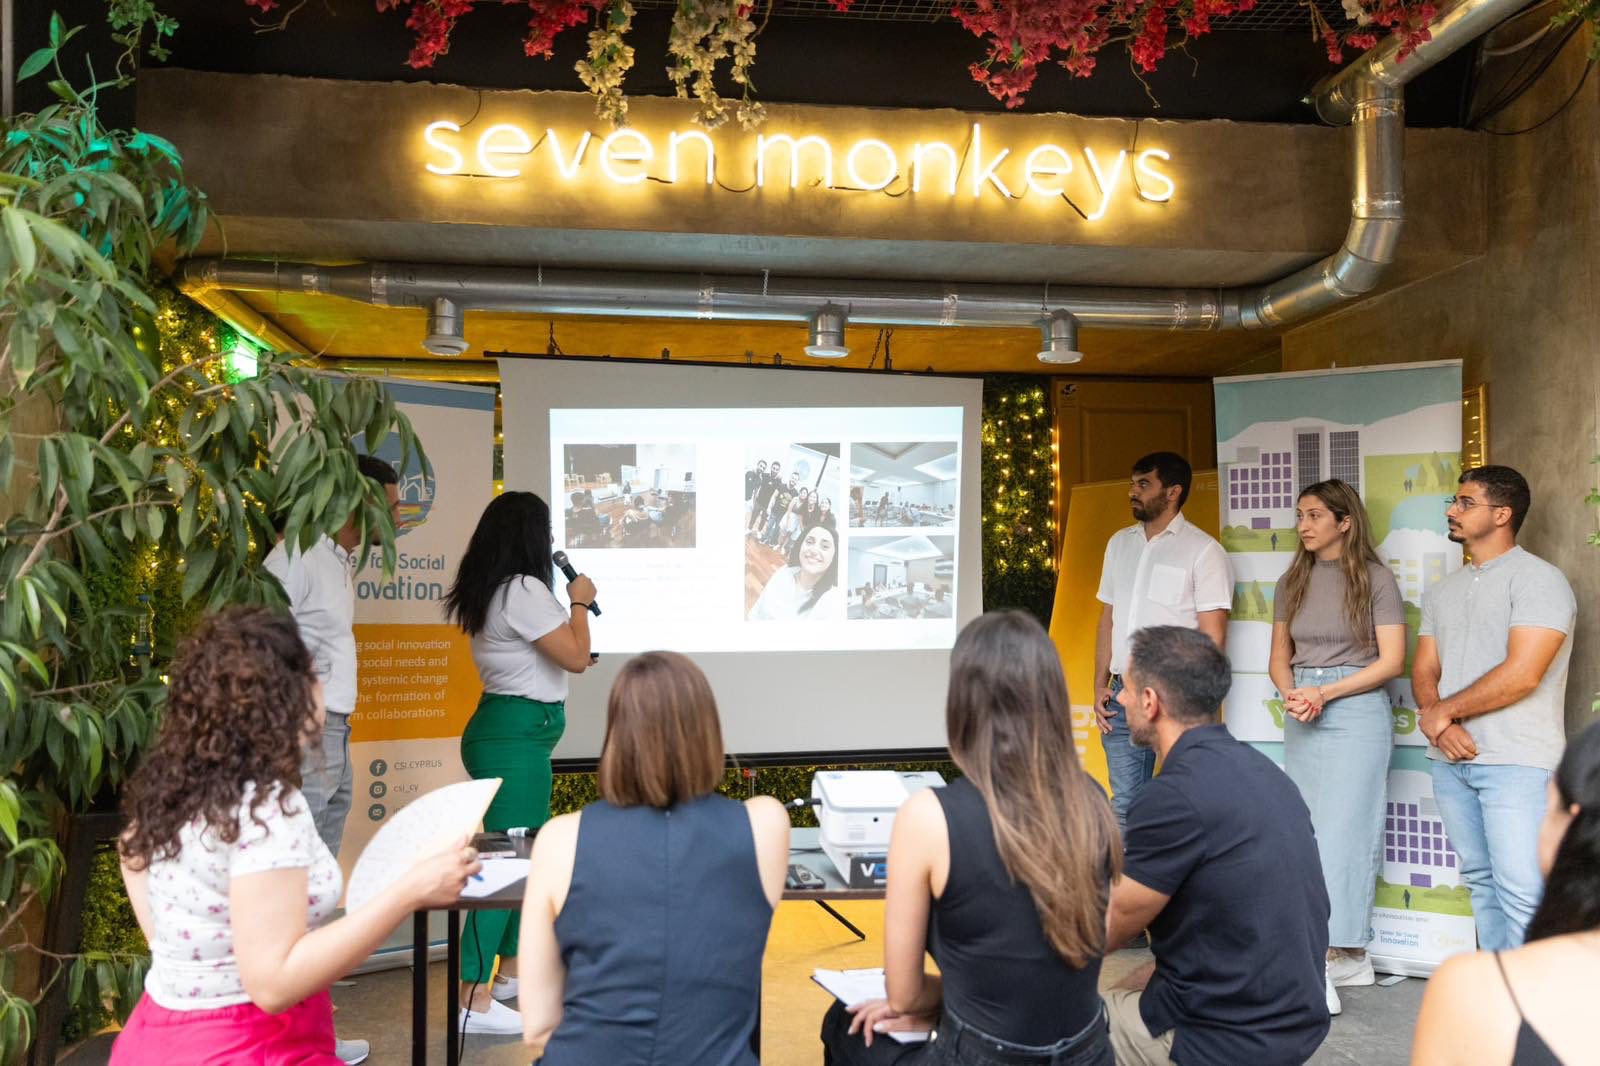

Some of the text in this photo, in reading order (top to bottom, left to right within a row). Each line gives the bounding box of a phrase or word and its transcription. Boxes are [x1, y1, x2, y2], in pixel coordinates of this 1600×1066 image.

[423, 120, 1175, 221] seven monkeys
[398, 553, 445, 570] Social
[357, 575, 442, 601] ovation
[364, 639, 394, 650] social
[397, 639, 451, 650] innovation
[363, 656, 392, 668] social
[396, 657, 426, 667] needs
[428, 656, 448, 667] and
[362, 673, 448, 687] systemic change
[375, 691, 431, 703] formation
[434, 689, 446, 700] of
[366, 707, 446, 720] collaborations
